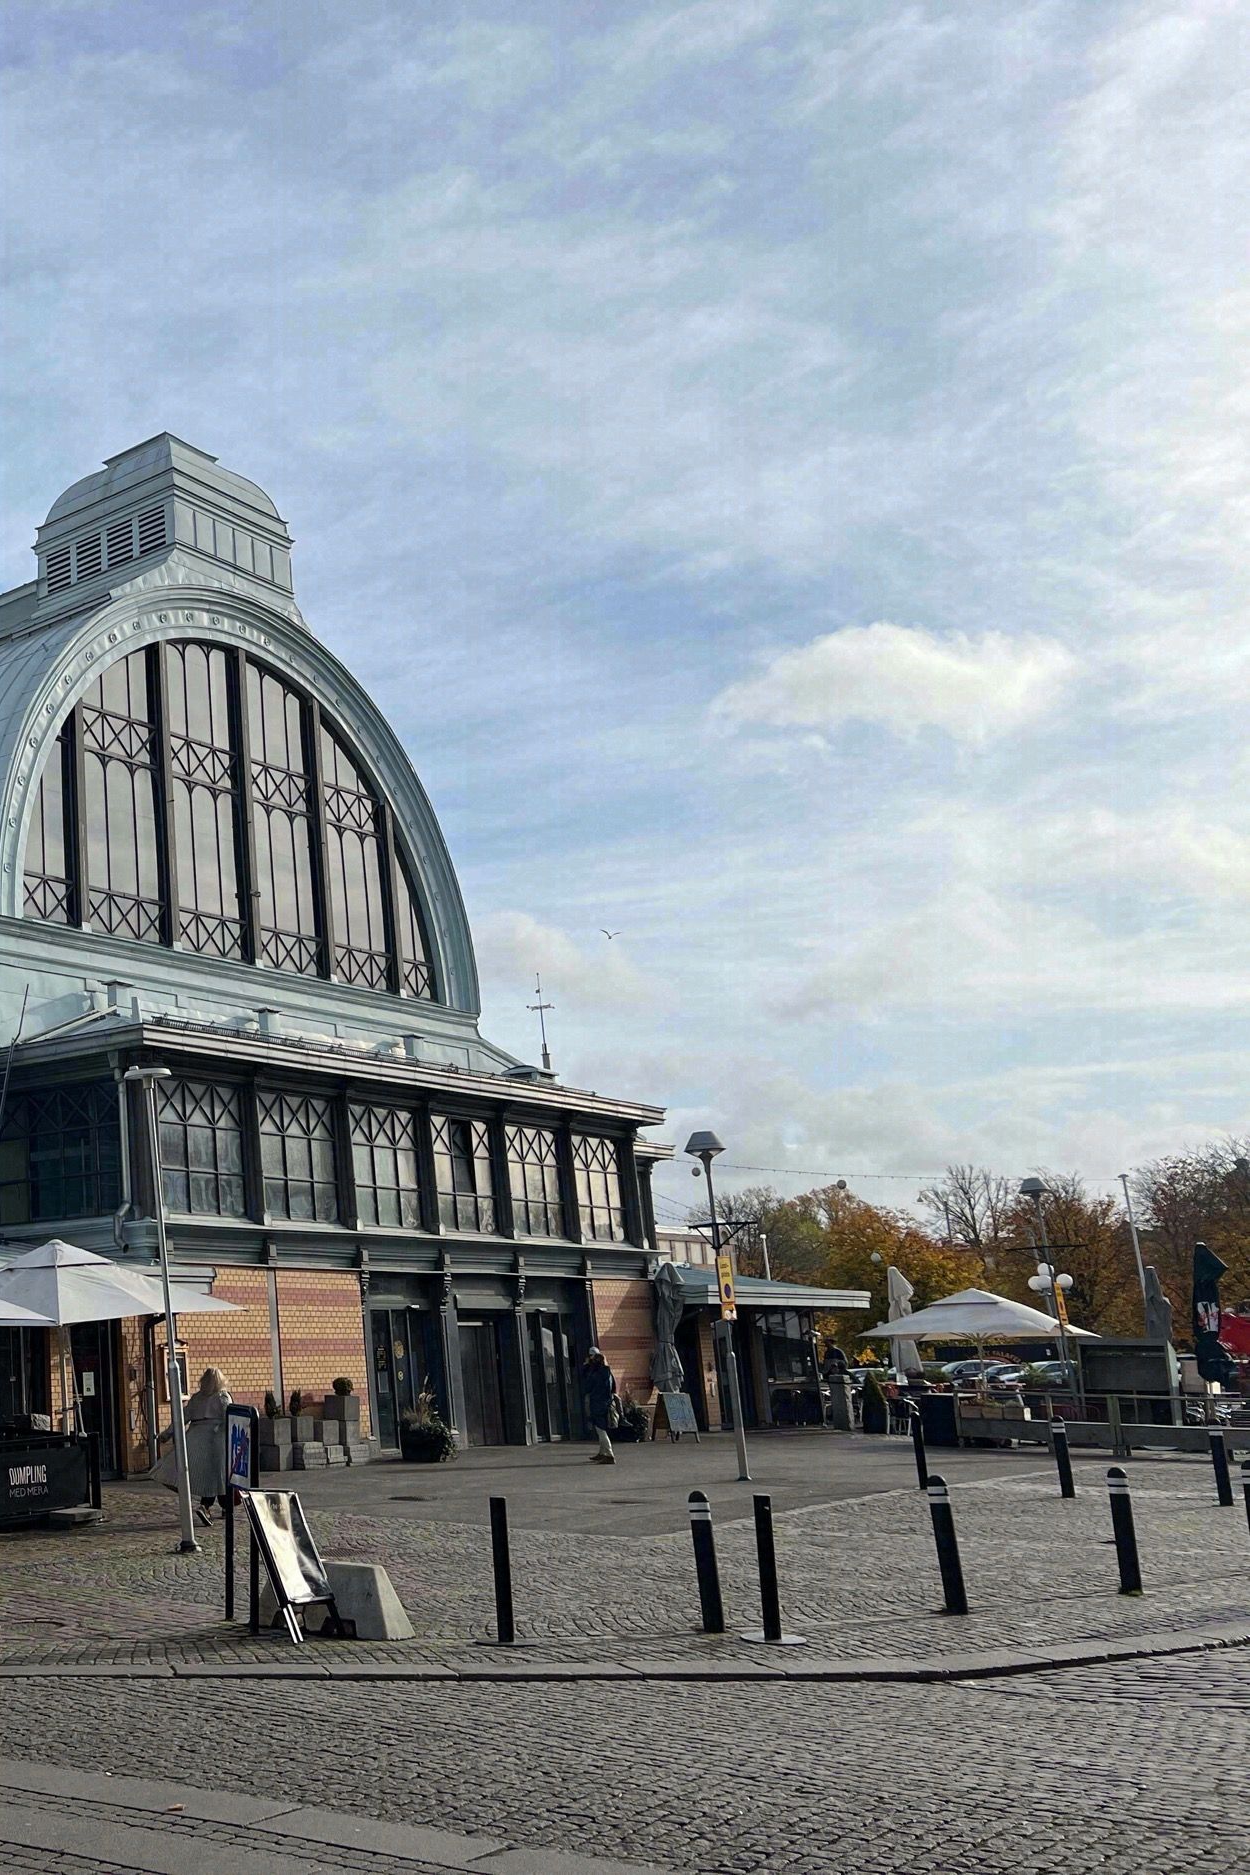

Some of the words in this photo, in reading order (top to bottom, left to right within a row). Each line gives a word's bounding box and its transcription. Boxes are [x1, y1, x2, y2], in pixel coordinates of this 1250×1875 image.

[8, 1464, 47, 1486] DUMPLING
[9, 1487, 26, 1498] MED
[27, 1485, 49, 1496] MERA
